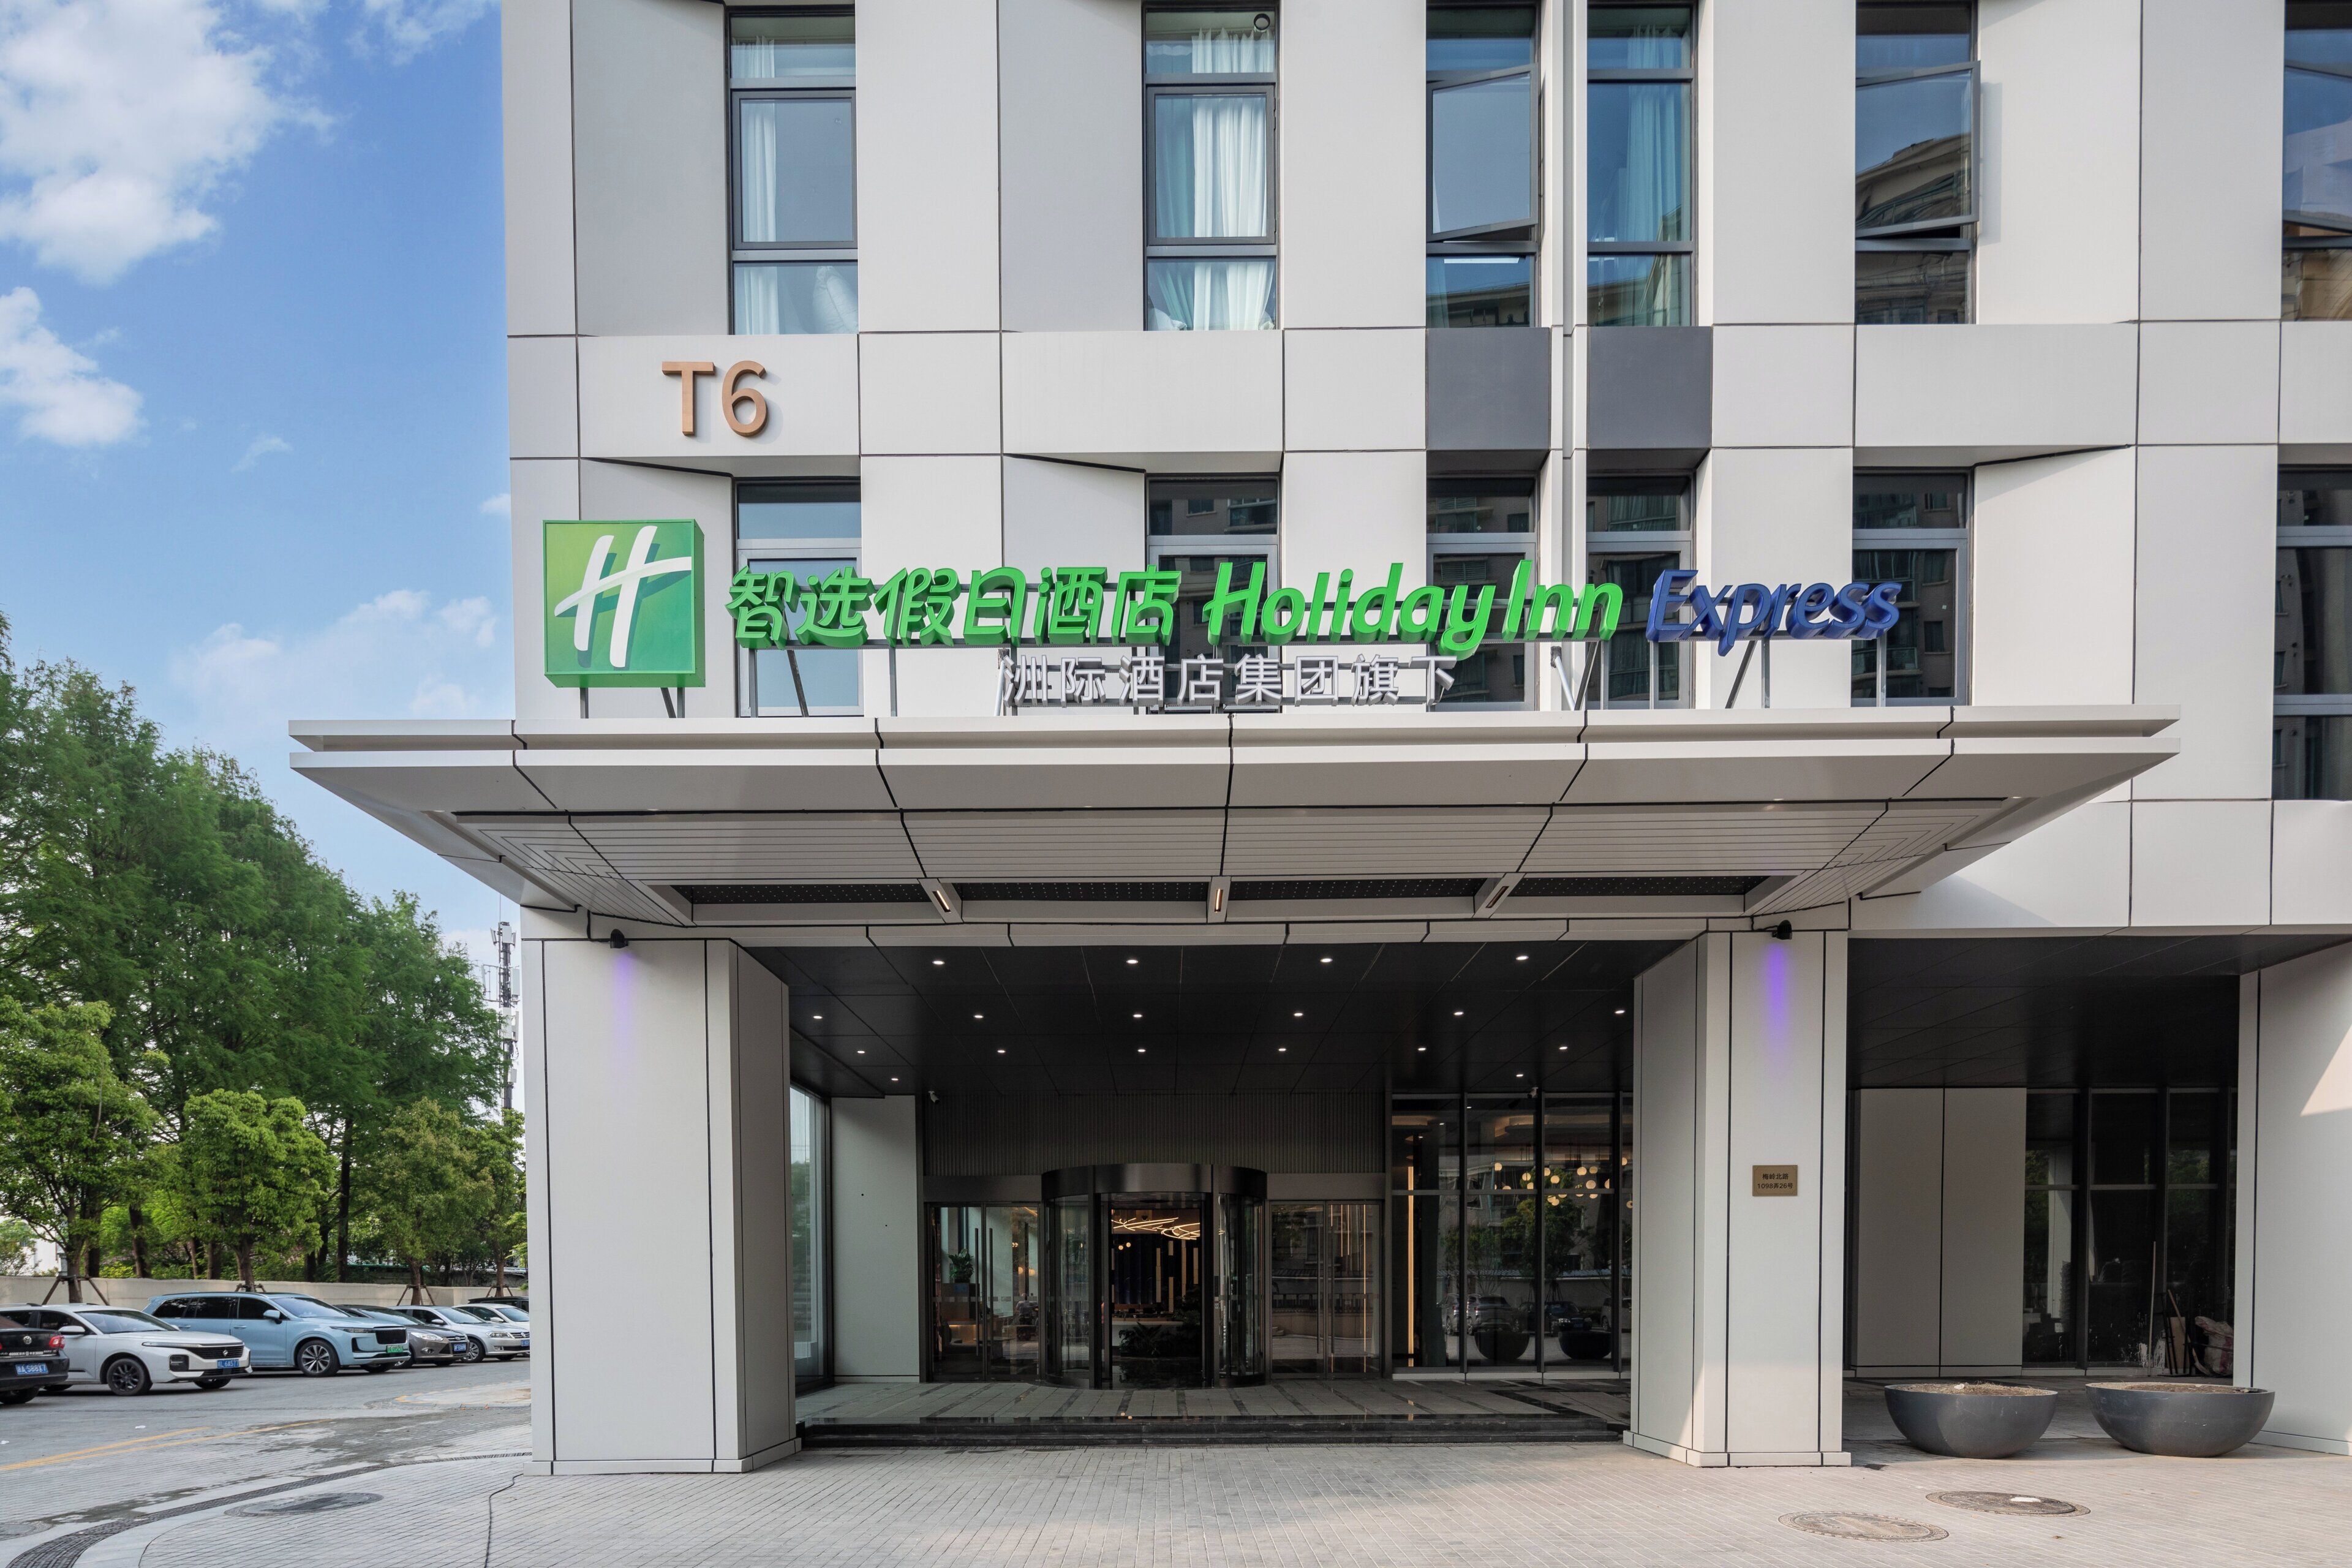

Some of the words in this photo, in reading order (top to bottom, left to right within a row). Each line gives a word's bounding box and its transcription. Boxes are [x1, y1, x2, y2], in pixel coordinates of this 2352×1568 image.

[662, 360, 769, 437] T6
[725, 565, 1181, 650] 智选假日酒店
[1202, 562, 1494, 661] Holiday
[1501, 560, 1623, 641] Inn
[1646, 569, 1902, 657] Express
[1003, 653, 1458, 707] 洲际酒店集团旗下
